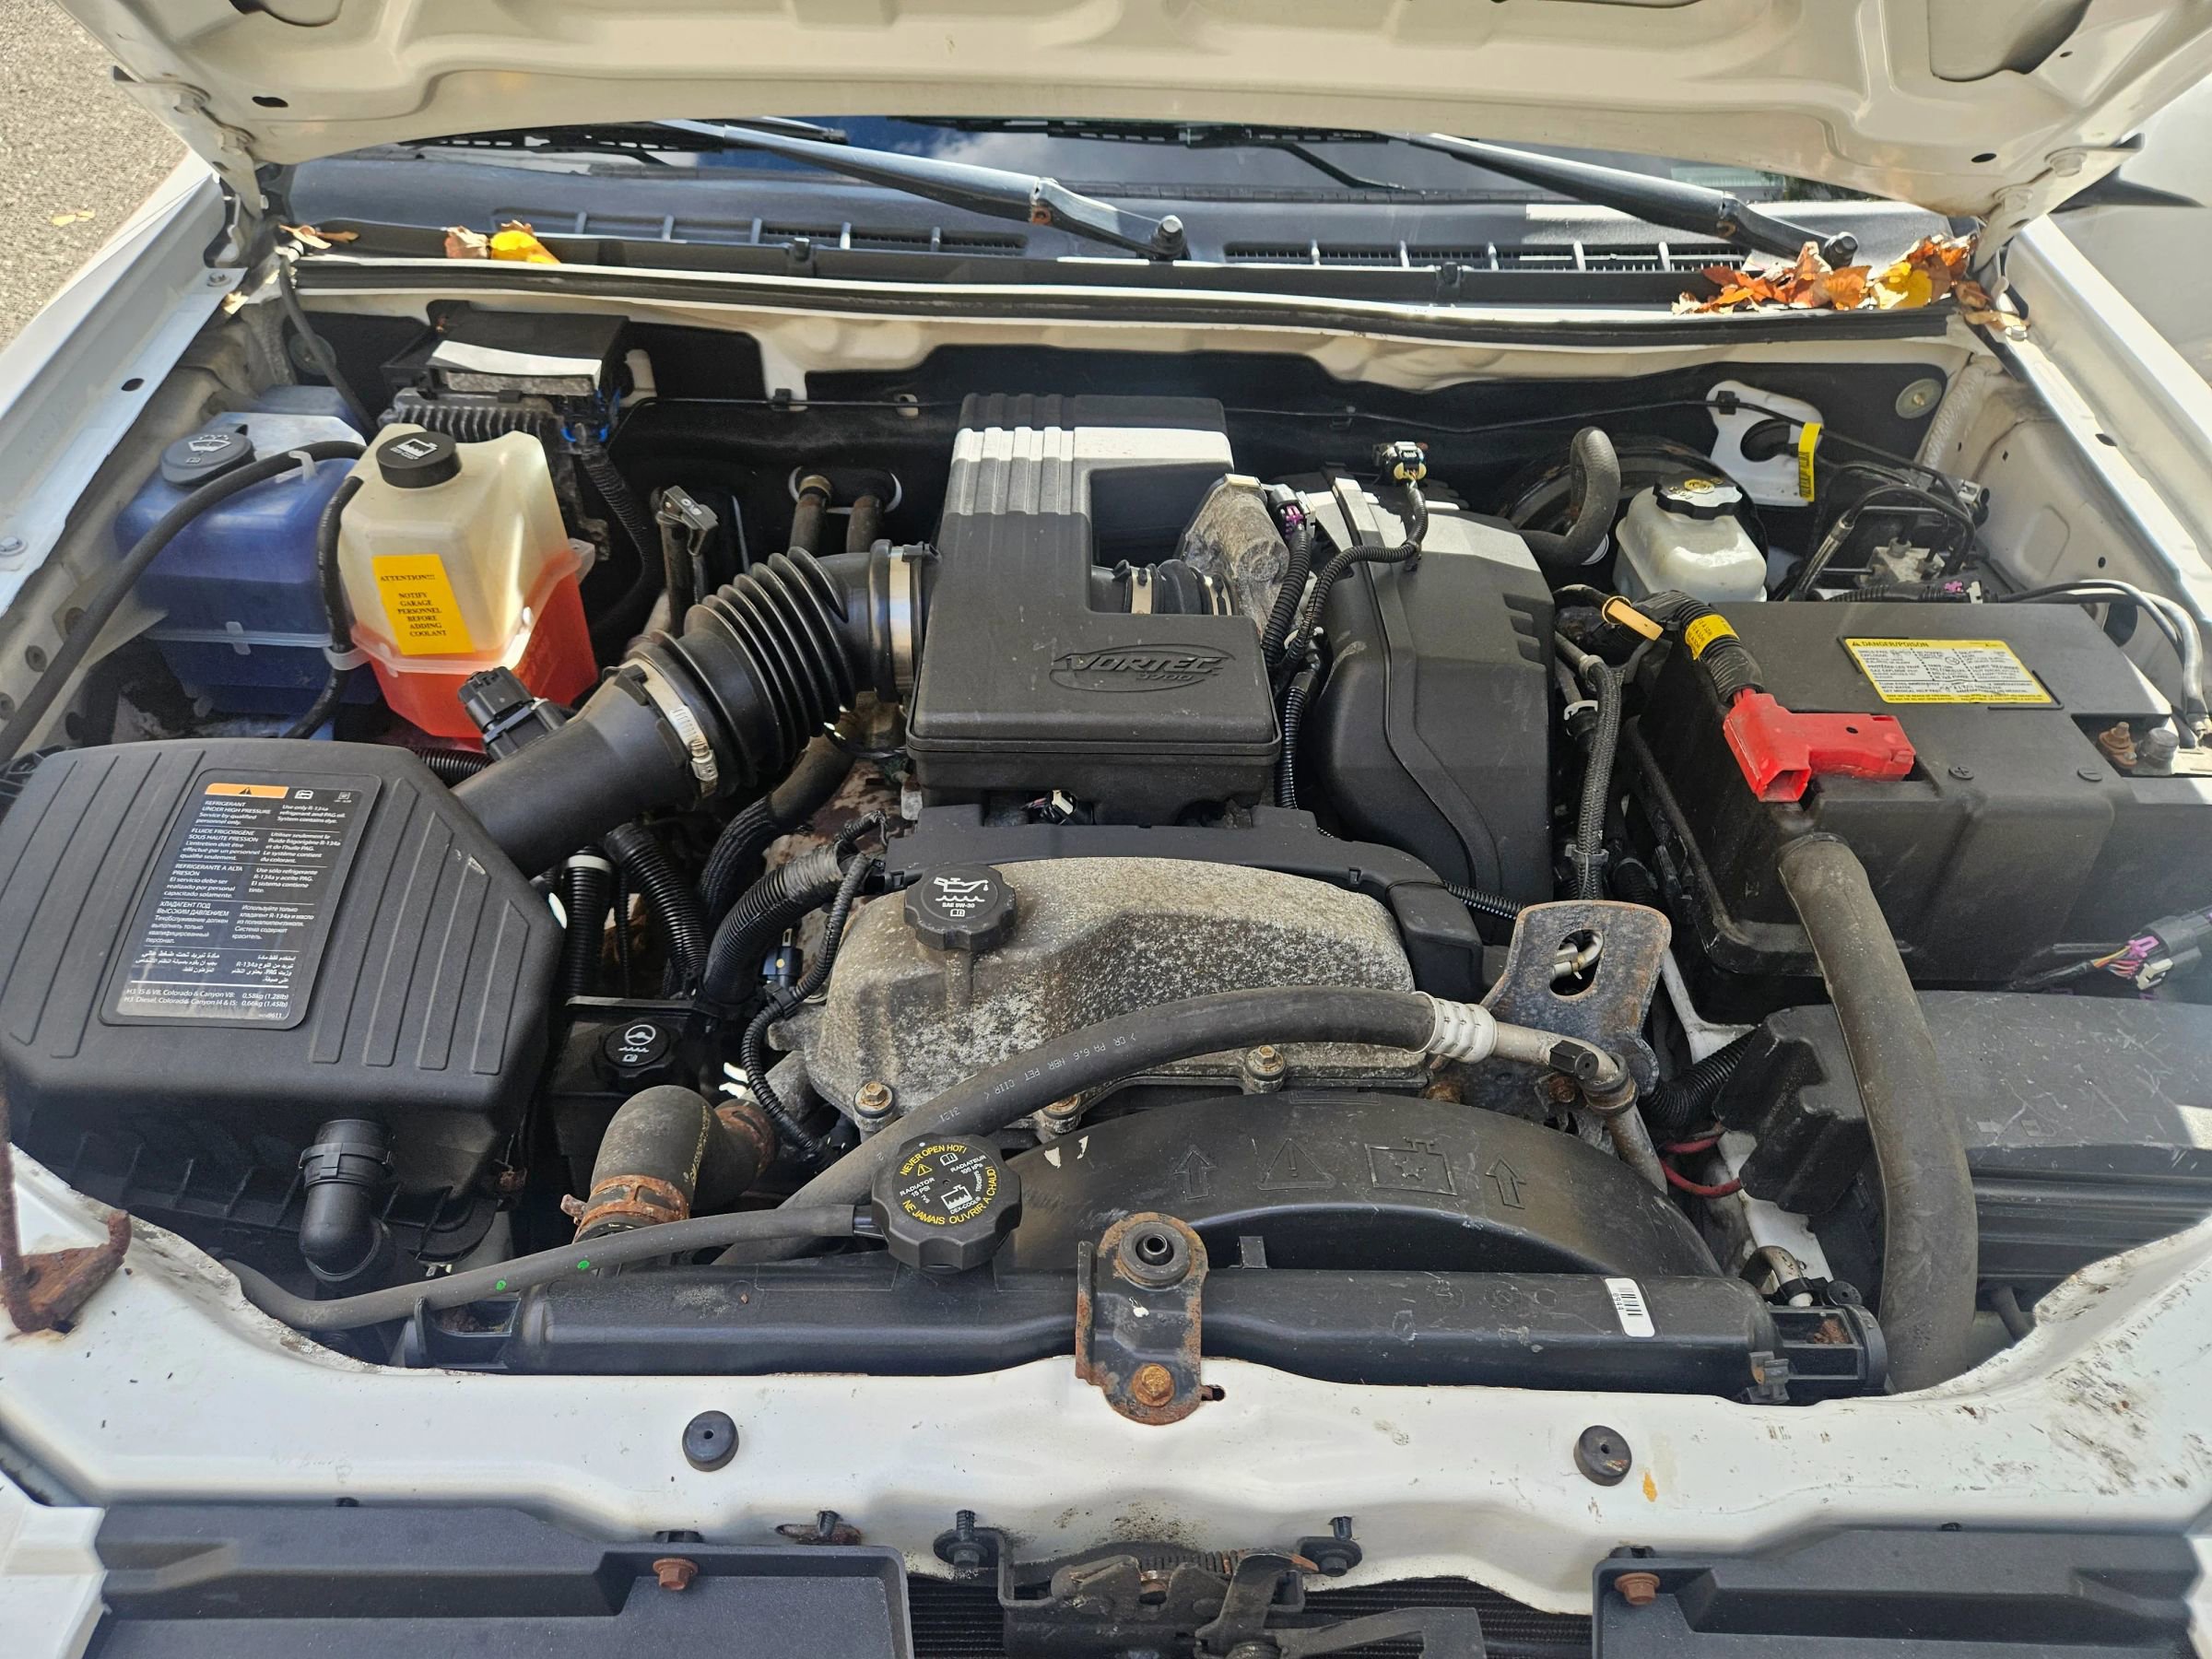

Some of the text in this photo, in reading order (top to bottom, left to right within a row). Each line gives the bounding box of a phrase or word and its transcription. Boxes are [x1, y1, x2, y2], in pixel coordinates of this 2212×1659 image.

[1065, 654, 1222, 674] VORTEC
[199, 990, 224, 998] Canyon
[1094, 1042, 1106, 1053] PA
[1112, 1035, 1126, 1047] CR
[1047, 1056, 1066, 1071] NBR
[1024, 1067, 1041, 1081] PET
[899, 1144, 968, 1176] NEVER OPEN HOT!
[949, 1154, 988, 1173] RADIATEUR
[960, 1163, 983, 1174] 105 kPa
[899, 1177, 935, 1196] RADIATOR
[911, 1185, 931, 1197] 15 PSI
[902, 1199, 917, 1214] NE
[912, 1209, 946, 1225] JAMAIS
[948, 1203, 987, 1225] OUVRIR
[983, 1166, 998, 1197] CHAUD!
